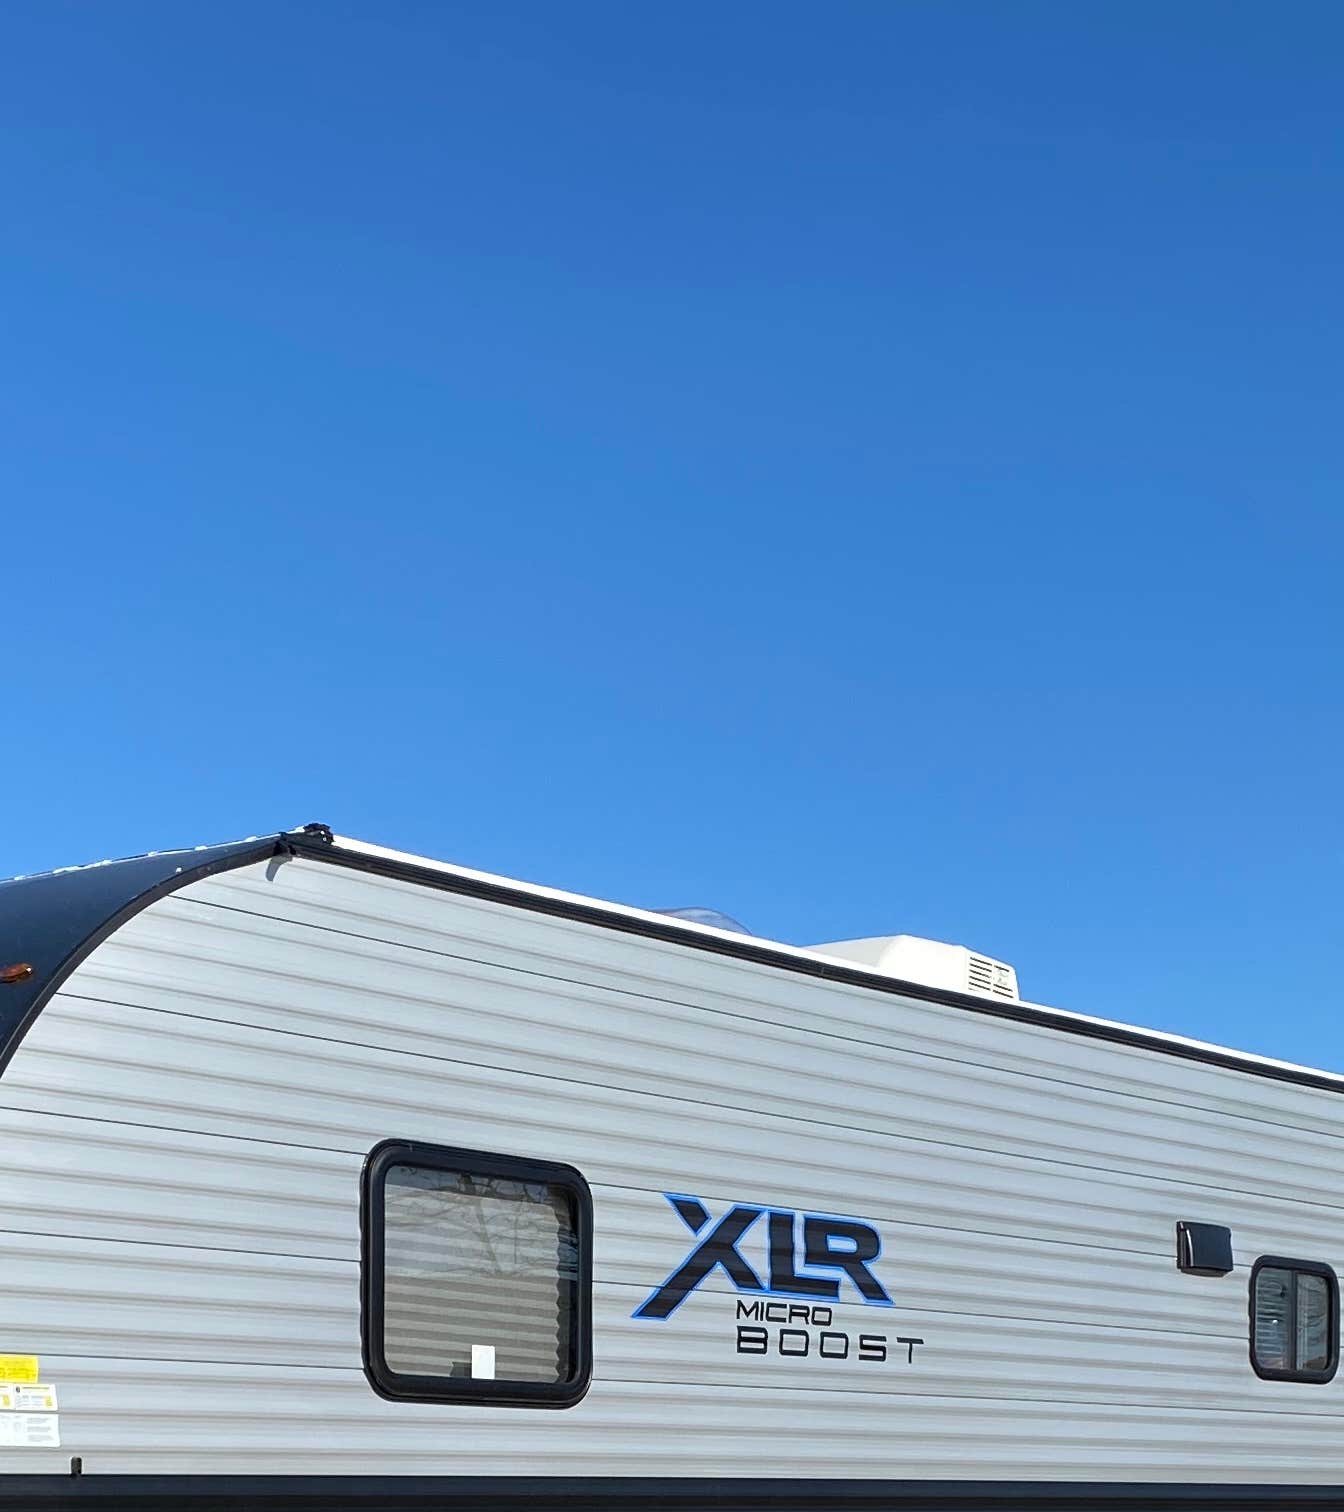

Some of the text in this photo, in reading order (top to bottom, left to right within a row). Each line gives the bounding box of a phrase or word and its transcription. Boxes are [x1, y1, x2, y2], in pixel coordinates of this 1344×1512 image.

[630, 1192, 896, 1321] XLR
[736, 1299, 833, 1326] MICRO
[736, 1326, 925, 1364] BOOST
